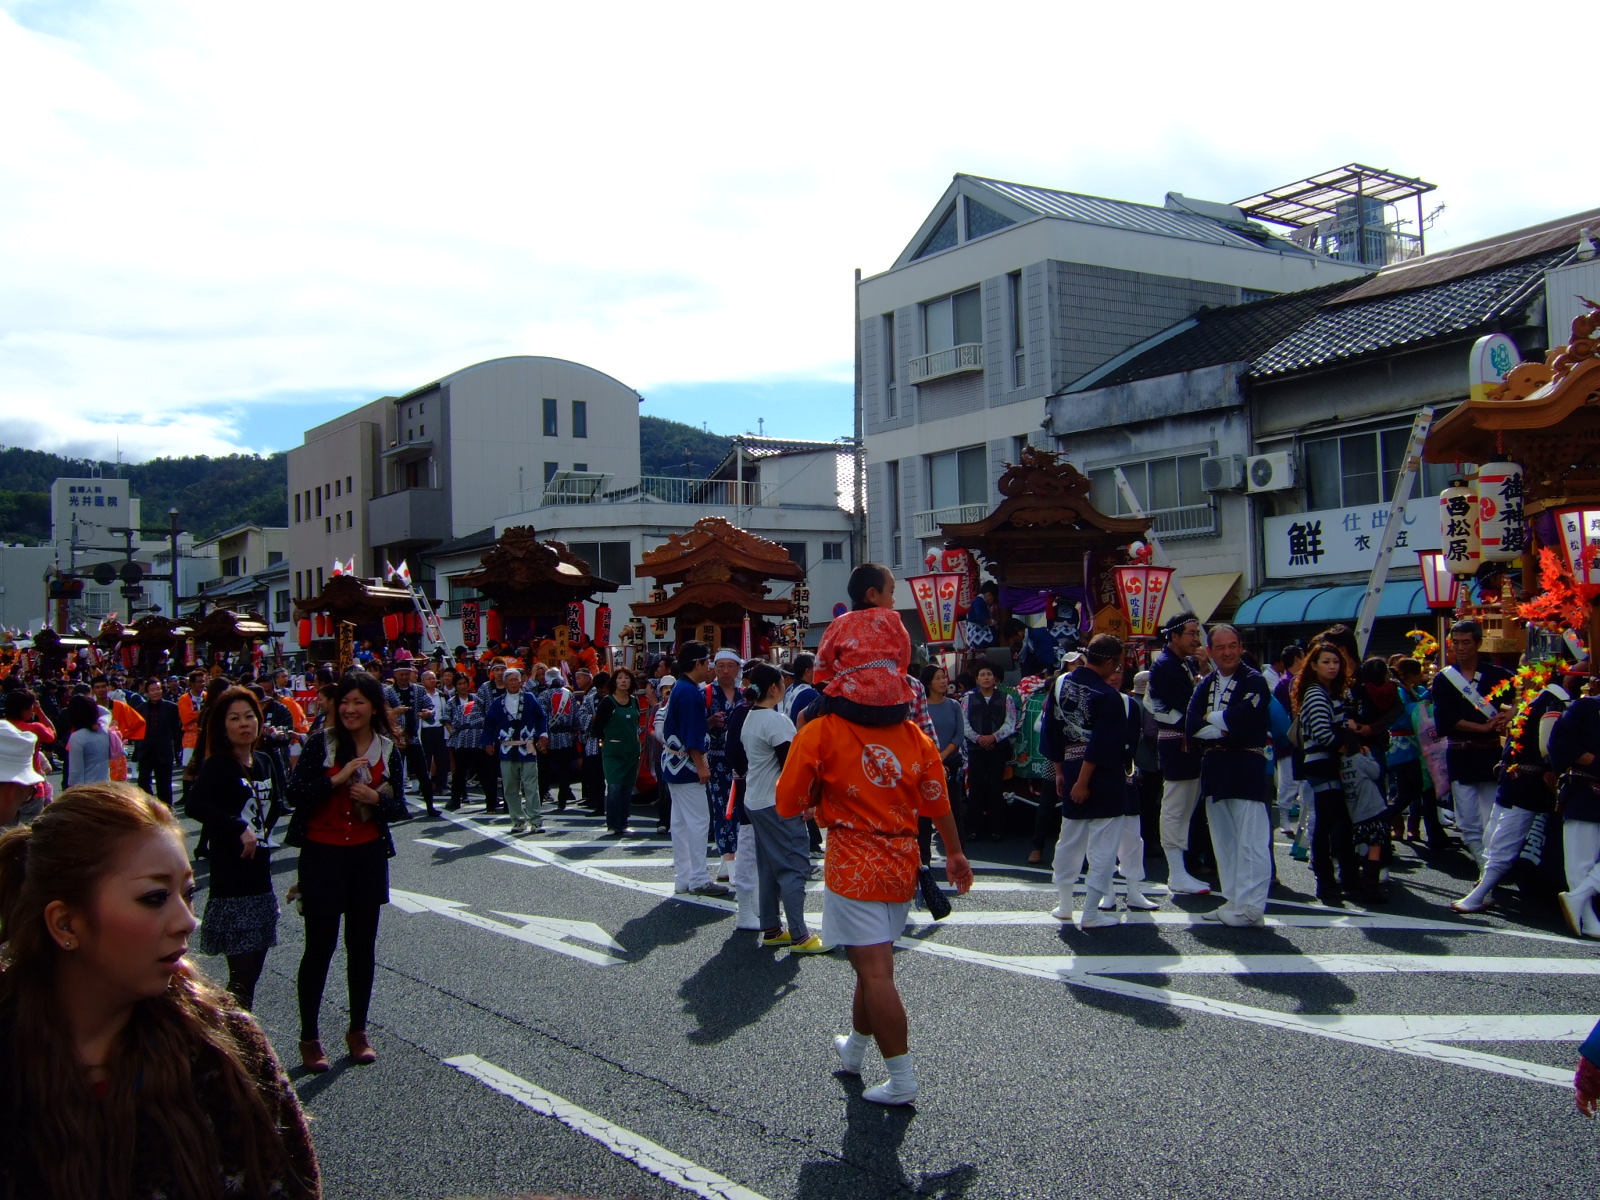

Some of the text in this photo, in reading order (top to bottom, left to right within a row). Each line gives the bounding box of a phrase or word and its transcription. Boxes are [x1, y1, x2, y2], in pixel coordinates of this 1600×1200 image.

[1342, 509, 1417, 532] 仕出し
[1446, 495, 1471, 562] 西松原
[1287, 519, 1325, 566] 鮮
[462, 605, 479, 644] 新魚町
[567, 604, 581, 642] 新魚町
[942, 602, 952, 633] 吹屋町
[1130, 597, 1141, 629] 吹屋町
